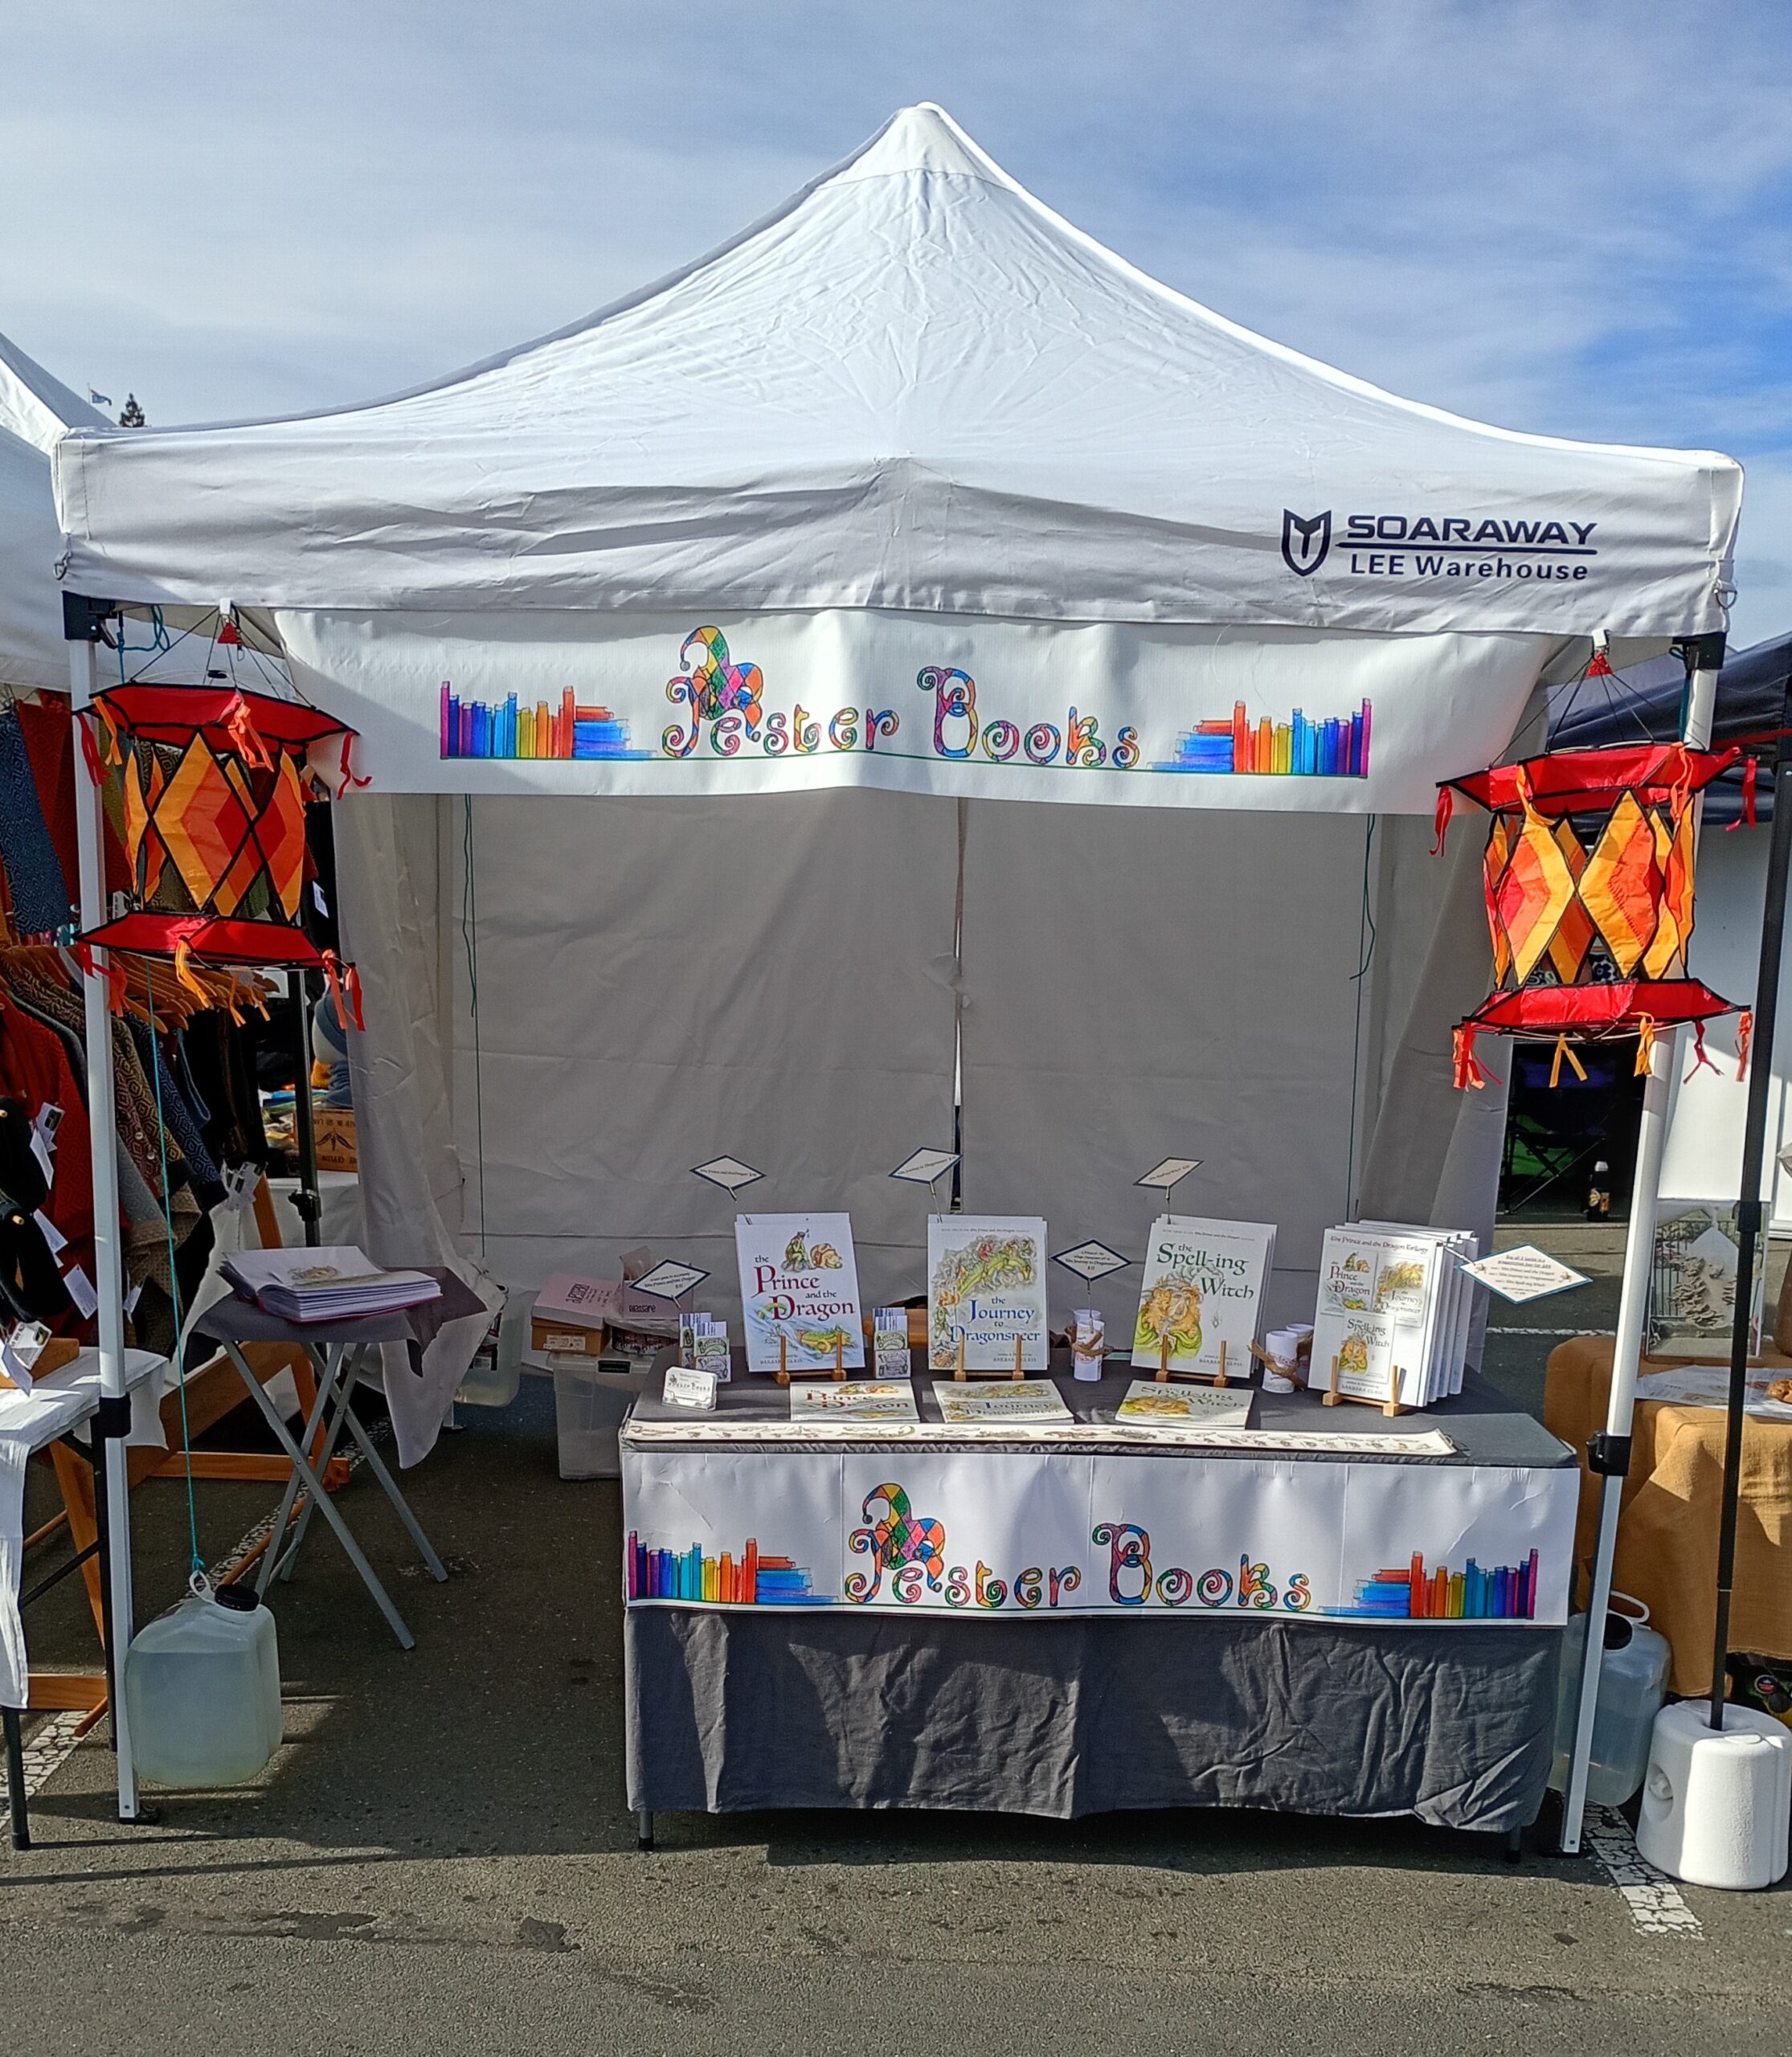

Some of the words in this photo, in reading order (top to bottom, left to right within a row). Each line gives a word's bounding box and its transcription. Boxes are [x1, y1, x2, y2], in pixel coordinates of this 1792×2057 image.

[1348, 515, 1598, 546] SOARAWAY
[1351, 554, 1406, 575] LEE
[1416, 556, 1589, 580] Warehouse
[662, 657, 900, 758] Jester
[918, 666, 1140, 769] Books
[755, 1255, 769, 1264] the
[1157, 1242, 1250, 1276] Spell-ing
[1178, 1243, 1193, 1252] the
[751, 1265, 820, 1298] Prince
[1328, 1266, 1358, 1282] Prince
[805, 1290, 821, 1298] and
[823, 1290, 837, 1298] the
[992, 1296, 1006, 1305] the
[1198, 1277, 1254, 1300] Witch
[1333, 1280, 1371, 1297] Dragon
[770, 1294, 856, 1322] Dragon
[968, 1299, 1035, 1324] Journey
[1364, 1335, 1390, 1348] Witch
[845, 1509, 1081, 1607] Jester
[1093, 1523, 1311, 1613] Books
